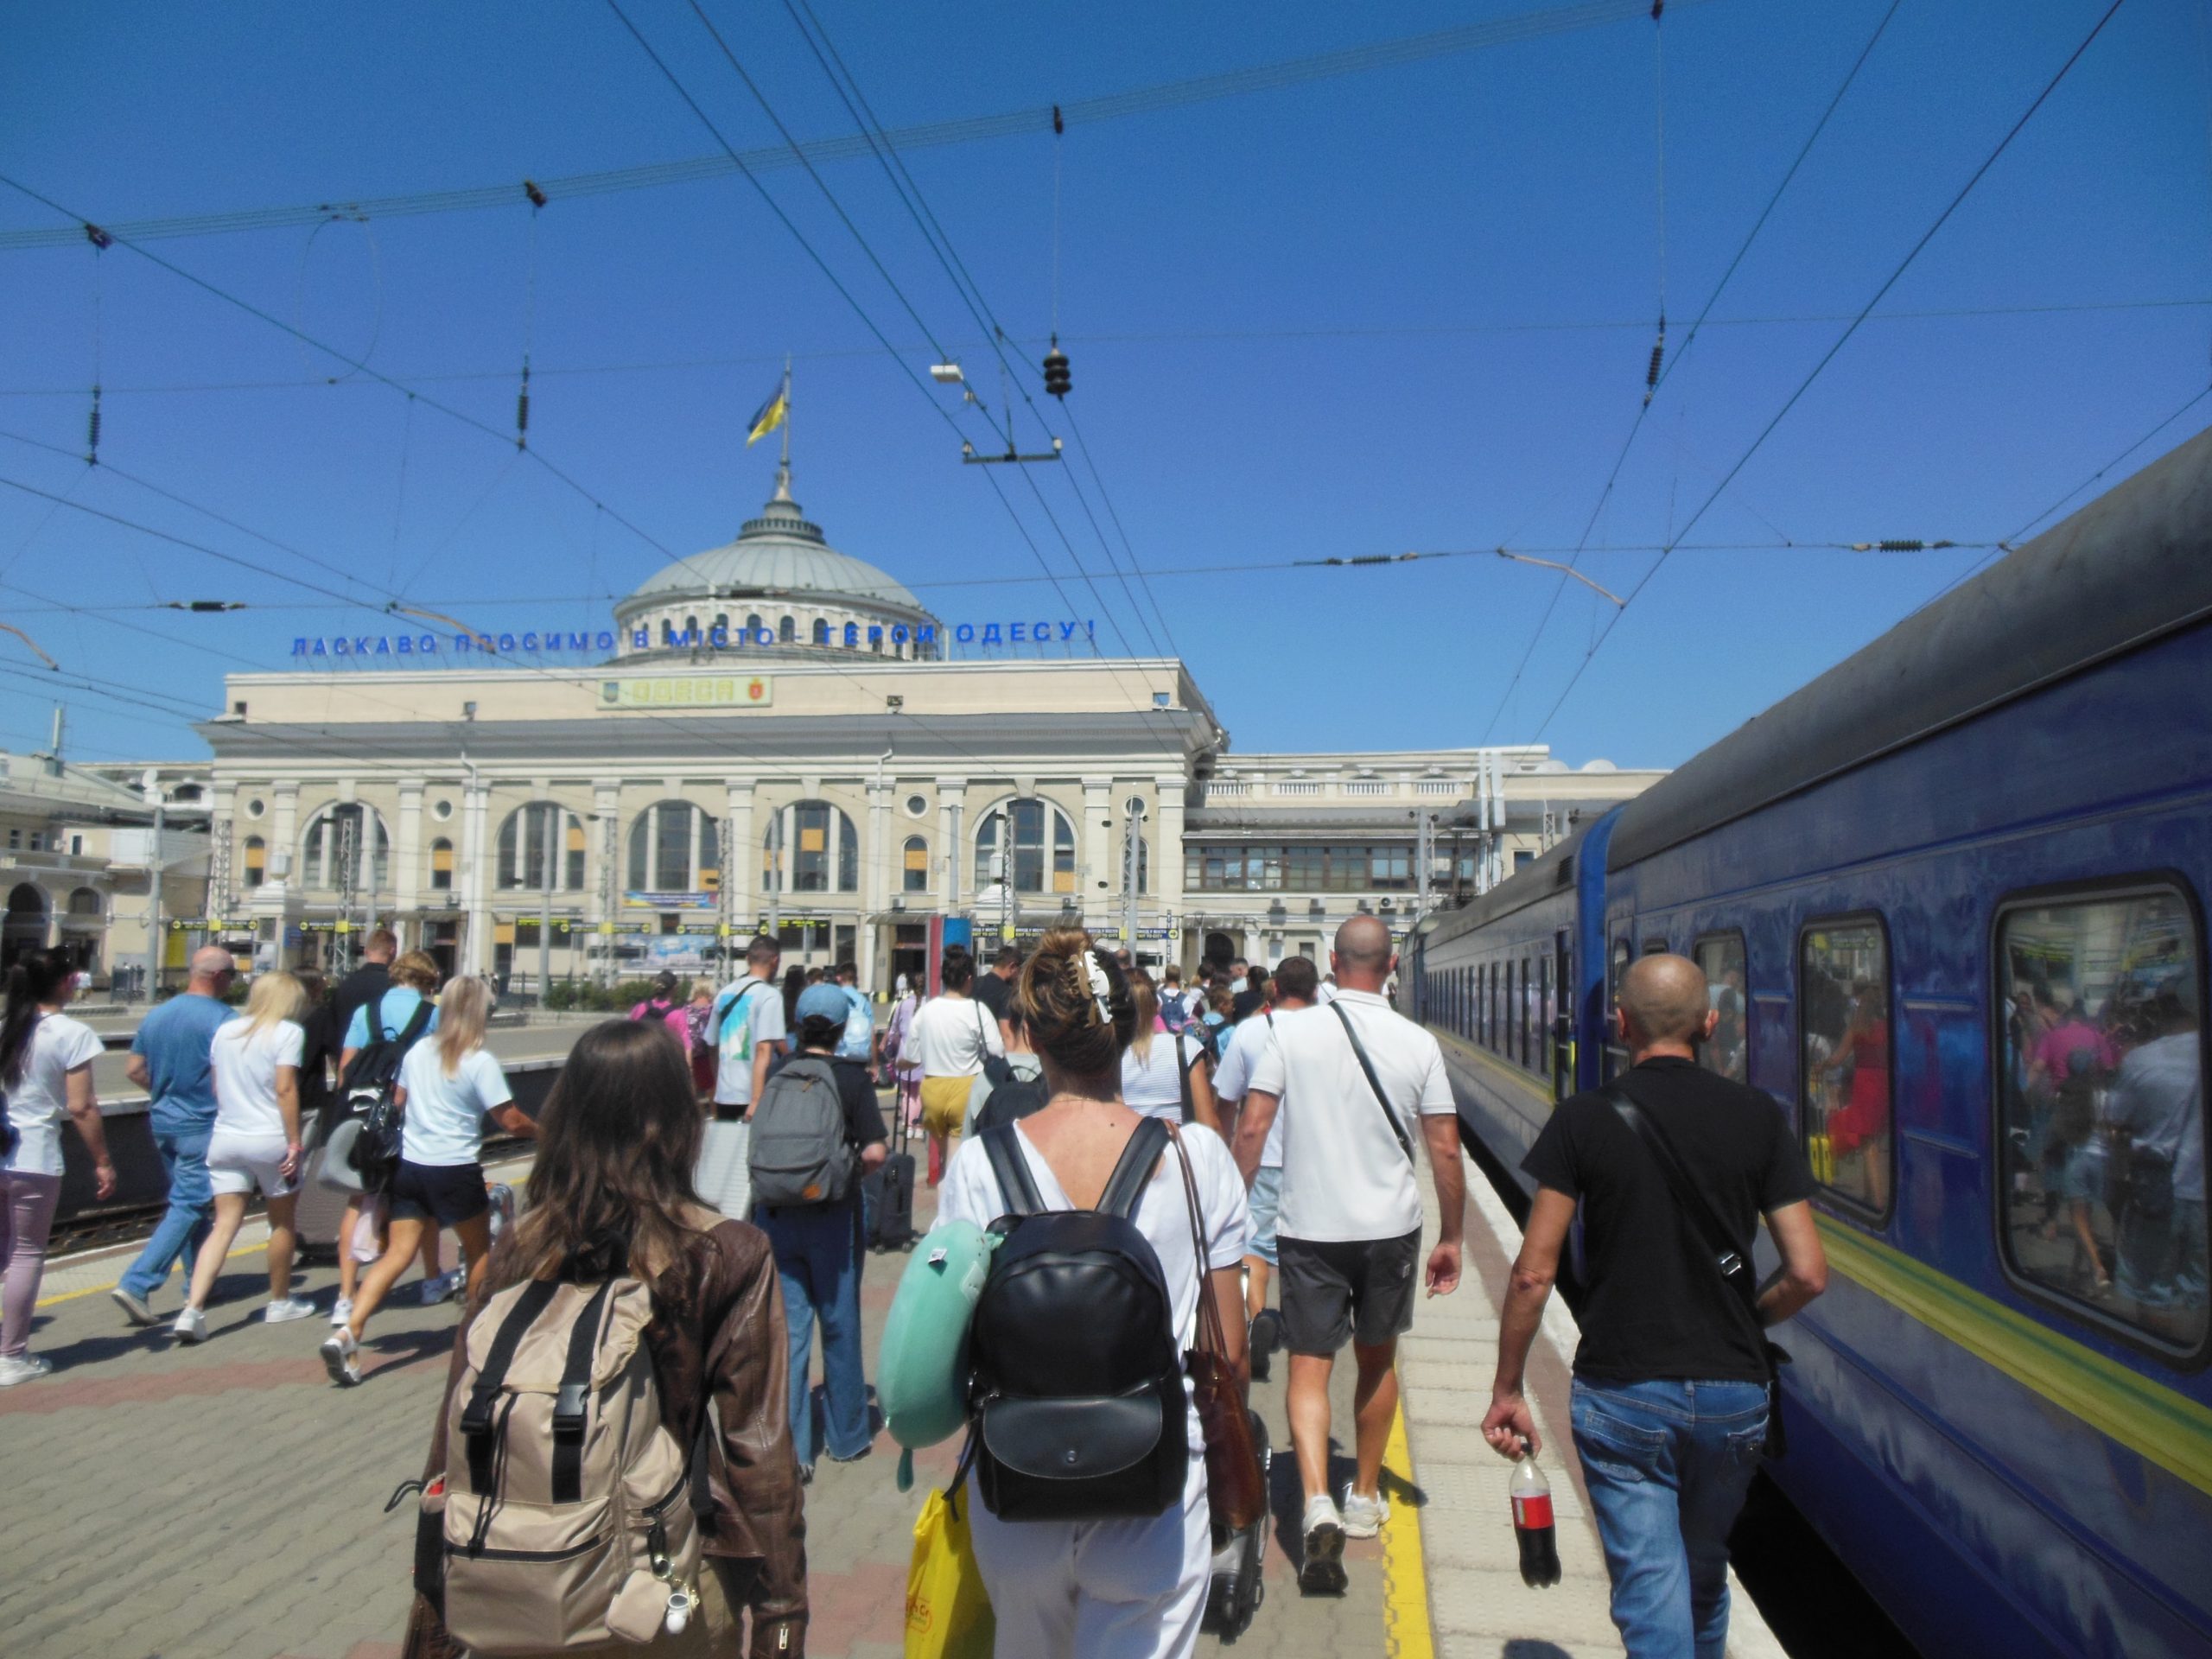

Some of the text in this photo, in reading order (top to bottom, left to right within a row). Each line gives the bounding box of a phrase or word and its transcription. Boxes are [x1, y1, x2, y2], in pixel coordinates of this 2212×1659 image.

[290, 634, 437, 656] ЛАСКАВО
[455, 631, 615, 652] ПРОСИМО
[633, 629, 650, 648] В
[668, 626, 775, 648] МІСТО
[823, 620, 935, 646] ГЕРОЙ
[956, 620, 1096, 646] ОДЕСУ!
